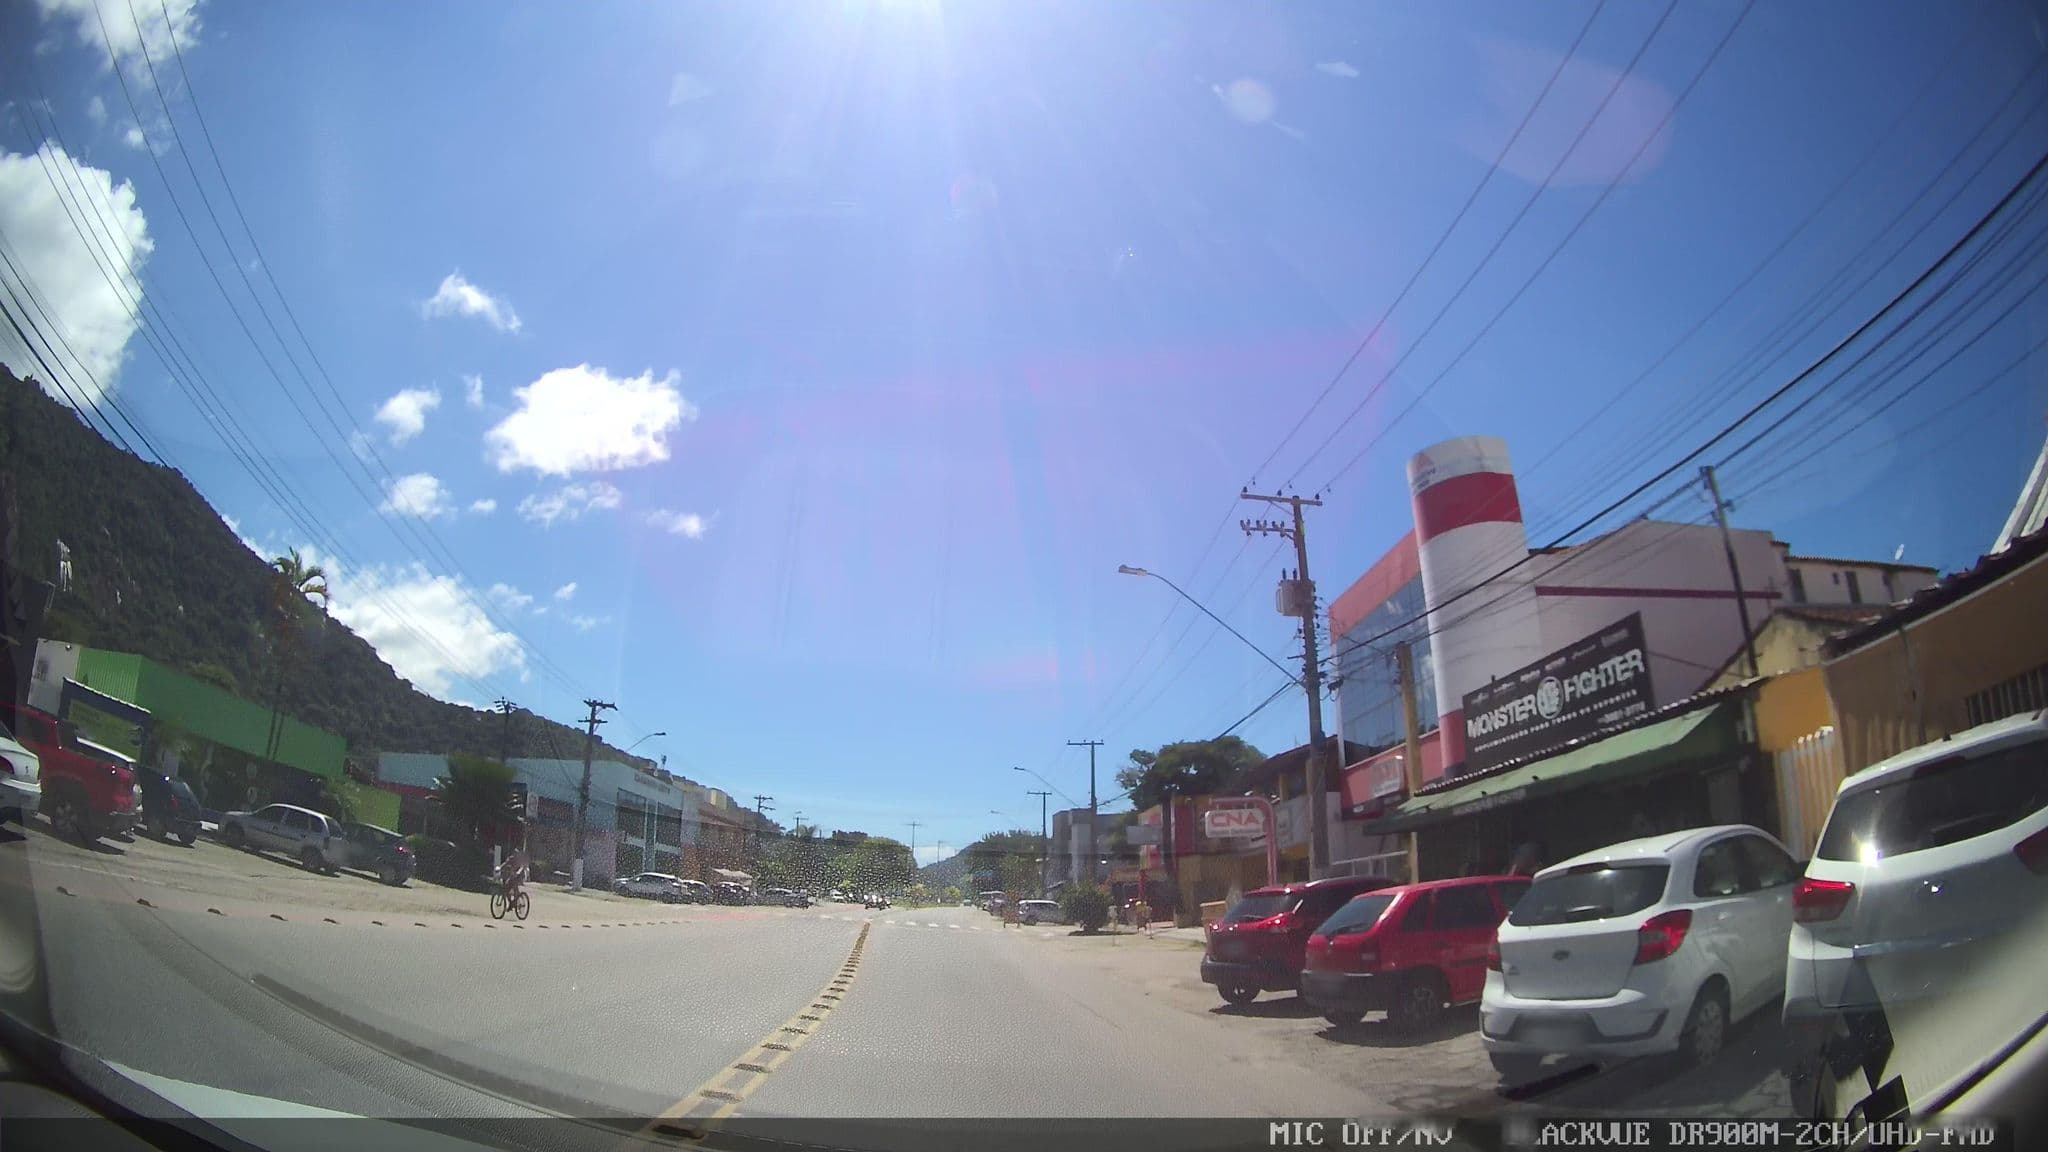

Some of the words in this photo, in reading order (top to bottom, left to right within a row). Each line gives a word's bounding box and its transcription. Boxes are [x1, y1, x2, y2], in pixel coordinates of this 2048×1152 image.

[1467, 694, 1537, 738] MONSTER
[1563, 649, 1645, 702] FIGHTER
[1211, 812, 1259, 827] CNA
